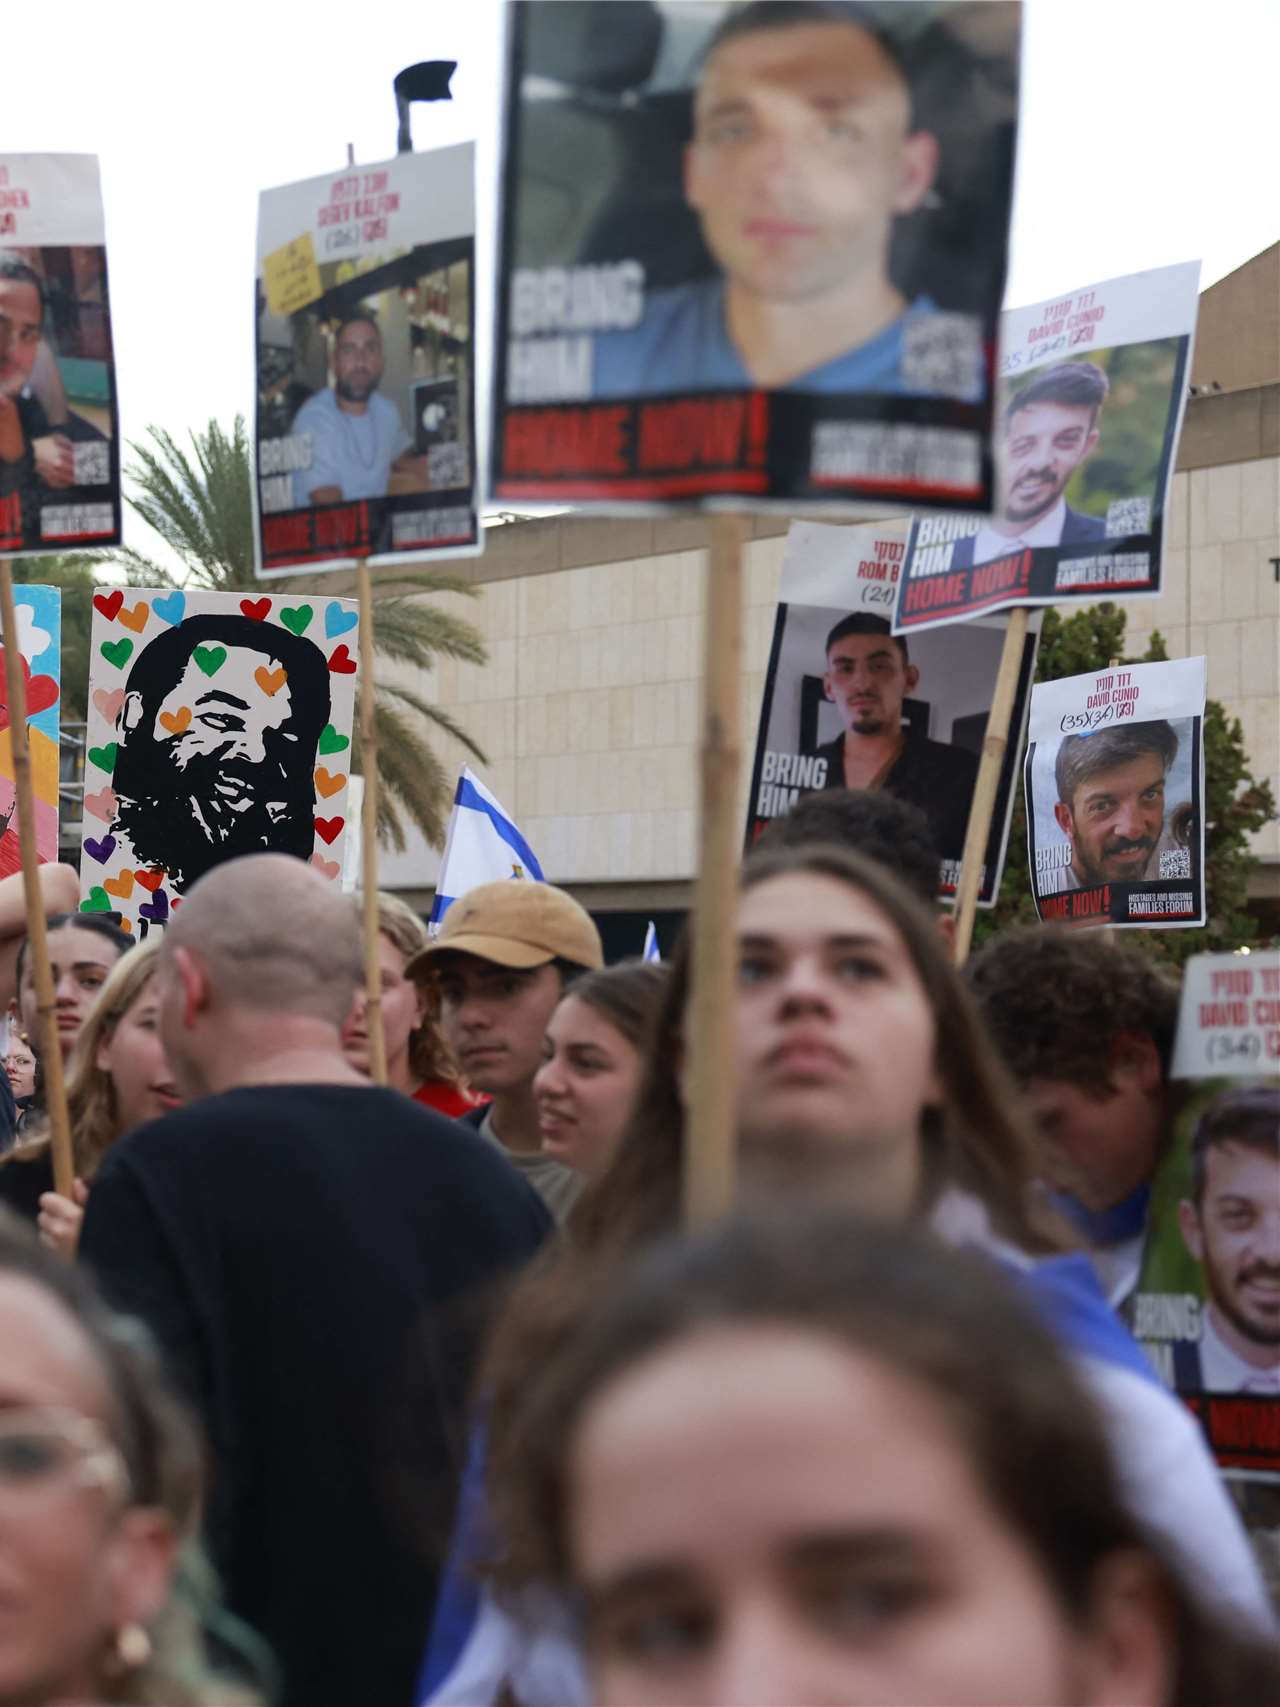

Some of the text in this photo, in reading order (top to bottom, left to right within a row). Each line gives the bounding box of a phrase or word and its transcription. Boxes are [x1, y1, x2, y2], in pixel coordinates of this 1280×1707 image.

[511, 259, 645, 336] BRING
[1027, 304, 1105, 344] DAVID CUNIO
[508, 332, 593, 403] HIM
[259, 432, 313, 477] BRING
[501, 405, 631, 476] HOME
[857, 560, 888, 581] ROM
[909, 542, 956, 579] HIM
[1056, 563, 1150, 586] FAMILIES FORUM
[904, 571, 969, 612] HOME
[1087, 686, 1140, 709] DAVID CUNIO
[1096, 672, 1132, 693] דוד קוניו
[760, 749, 829, 791] BRING
[756, 783, 800, 818] HIM
[1035, 842, 1073, 872] BRING
[1036, 868, 1060, 898] HIM
[1128, 893, 1157, 903] HOSTAGES
[1128, 899, 1194, 916] FAMILIES FORUM
[1199, 1000, 1249, 1030] DAVID
[1134, 1292, 1201, 1342] BRING
